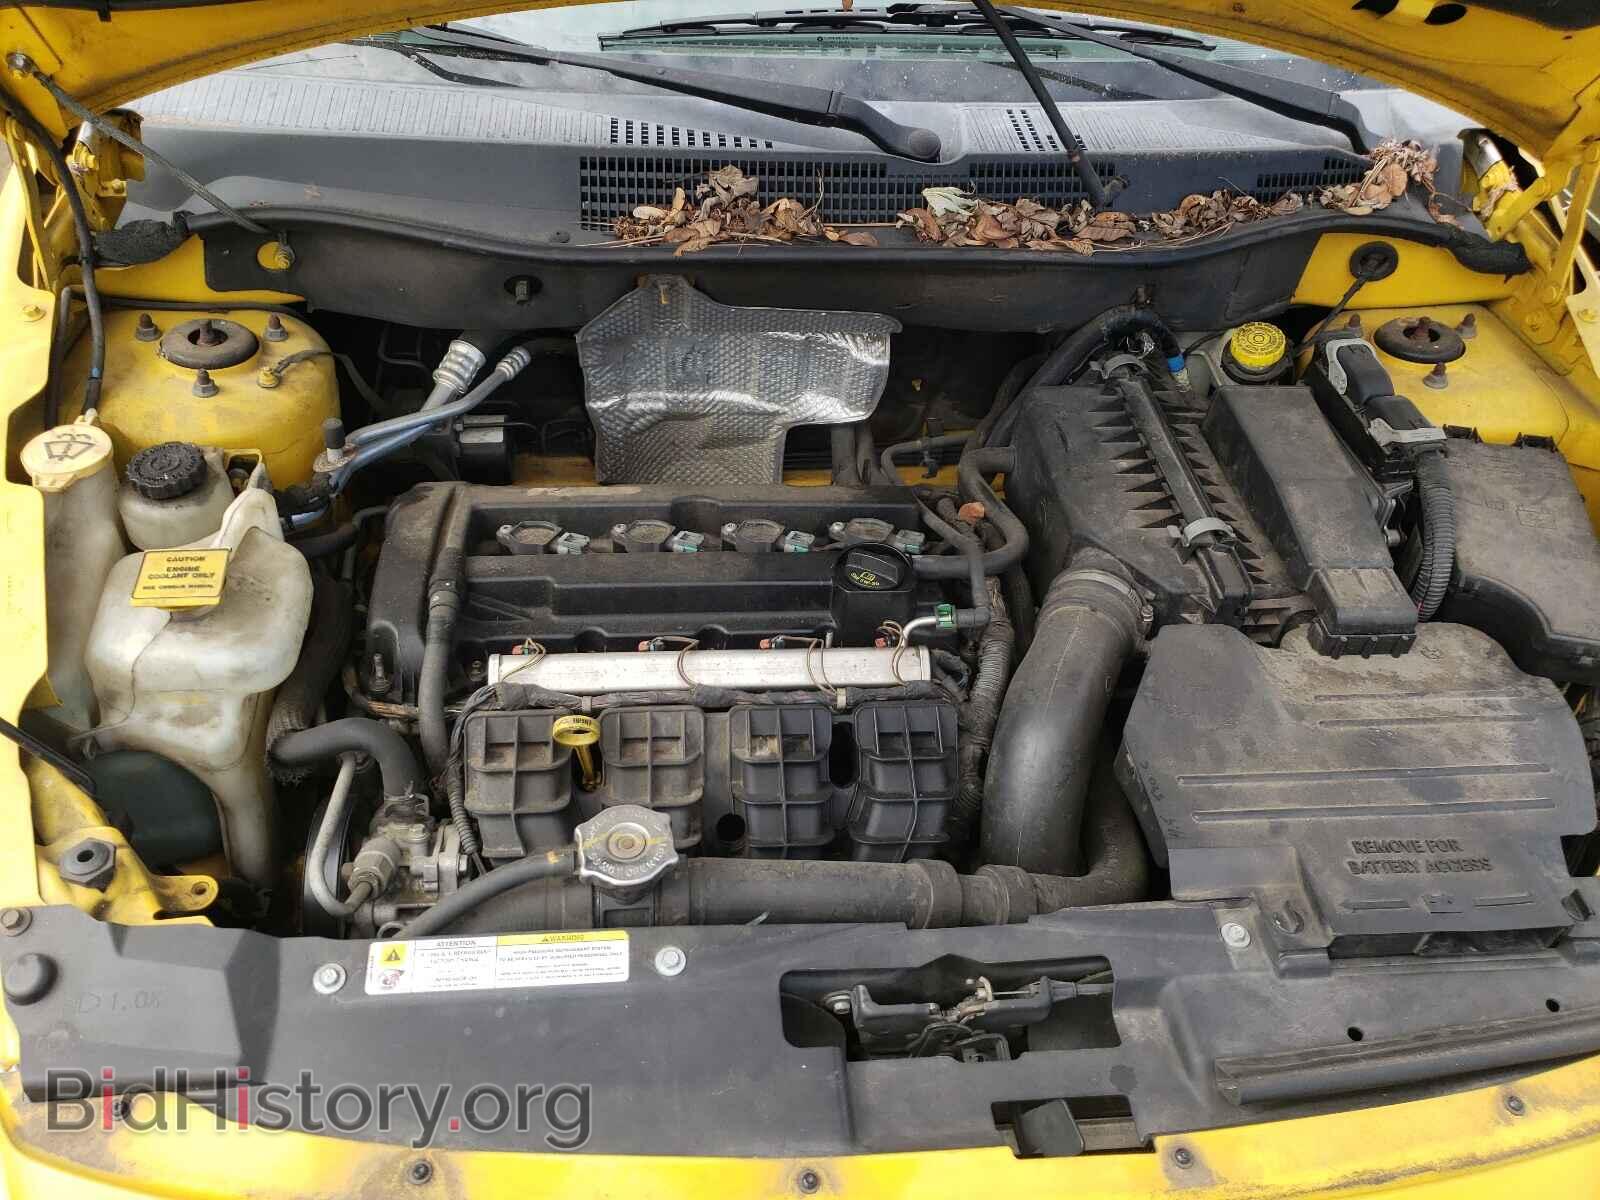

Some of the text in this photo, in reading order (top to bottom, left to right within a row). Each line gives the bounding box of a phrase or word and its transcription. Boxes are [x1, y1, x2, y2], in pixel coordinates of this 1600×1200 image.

[1351, 838, 1464, 854] REMOVE FOR
[1347, 857, 1494, 875] BATTERY ACCESS
[549, 934, 585, 942] WARNING
